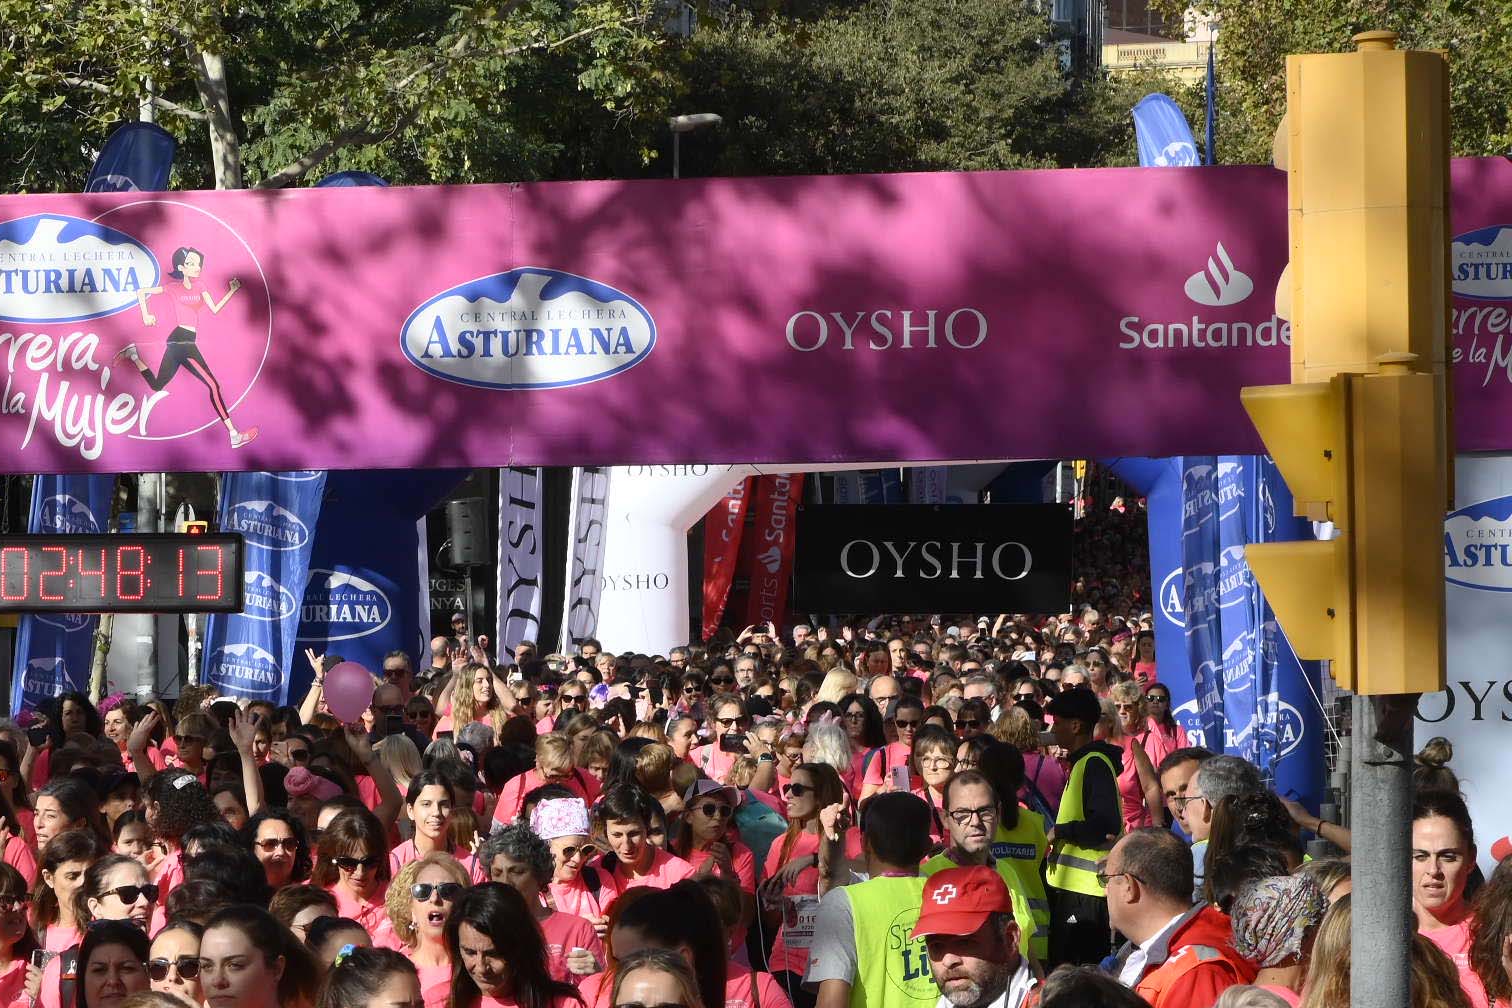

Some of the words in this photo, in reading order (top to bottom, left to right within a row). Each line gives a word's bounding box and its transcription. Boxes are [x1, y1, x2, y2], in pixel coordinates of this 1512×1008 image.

[63, 251, 136, 262] LECHERA
[460, 310, 541, 324] CENTRAL
[546, 308, 627, 322] LECHERA
[786, 308, 989, 353] OYSHO
[1119, 315, 1291, 349] Santande
[421, 315, 636, 360] ASTURIANA
[1, 374, 26, 414] la
[22, 372, 170, 460] Mujer
[227, 511, 300, 545] ASTURIANA
[505, 466, 540, 661] OYSH
[569, 466, 605, 648] OYSH
[840, 538, 1033, 580] OYSHO
[302, 603, 382, 624] URIANA
